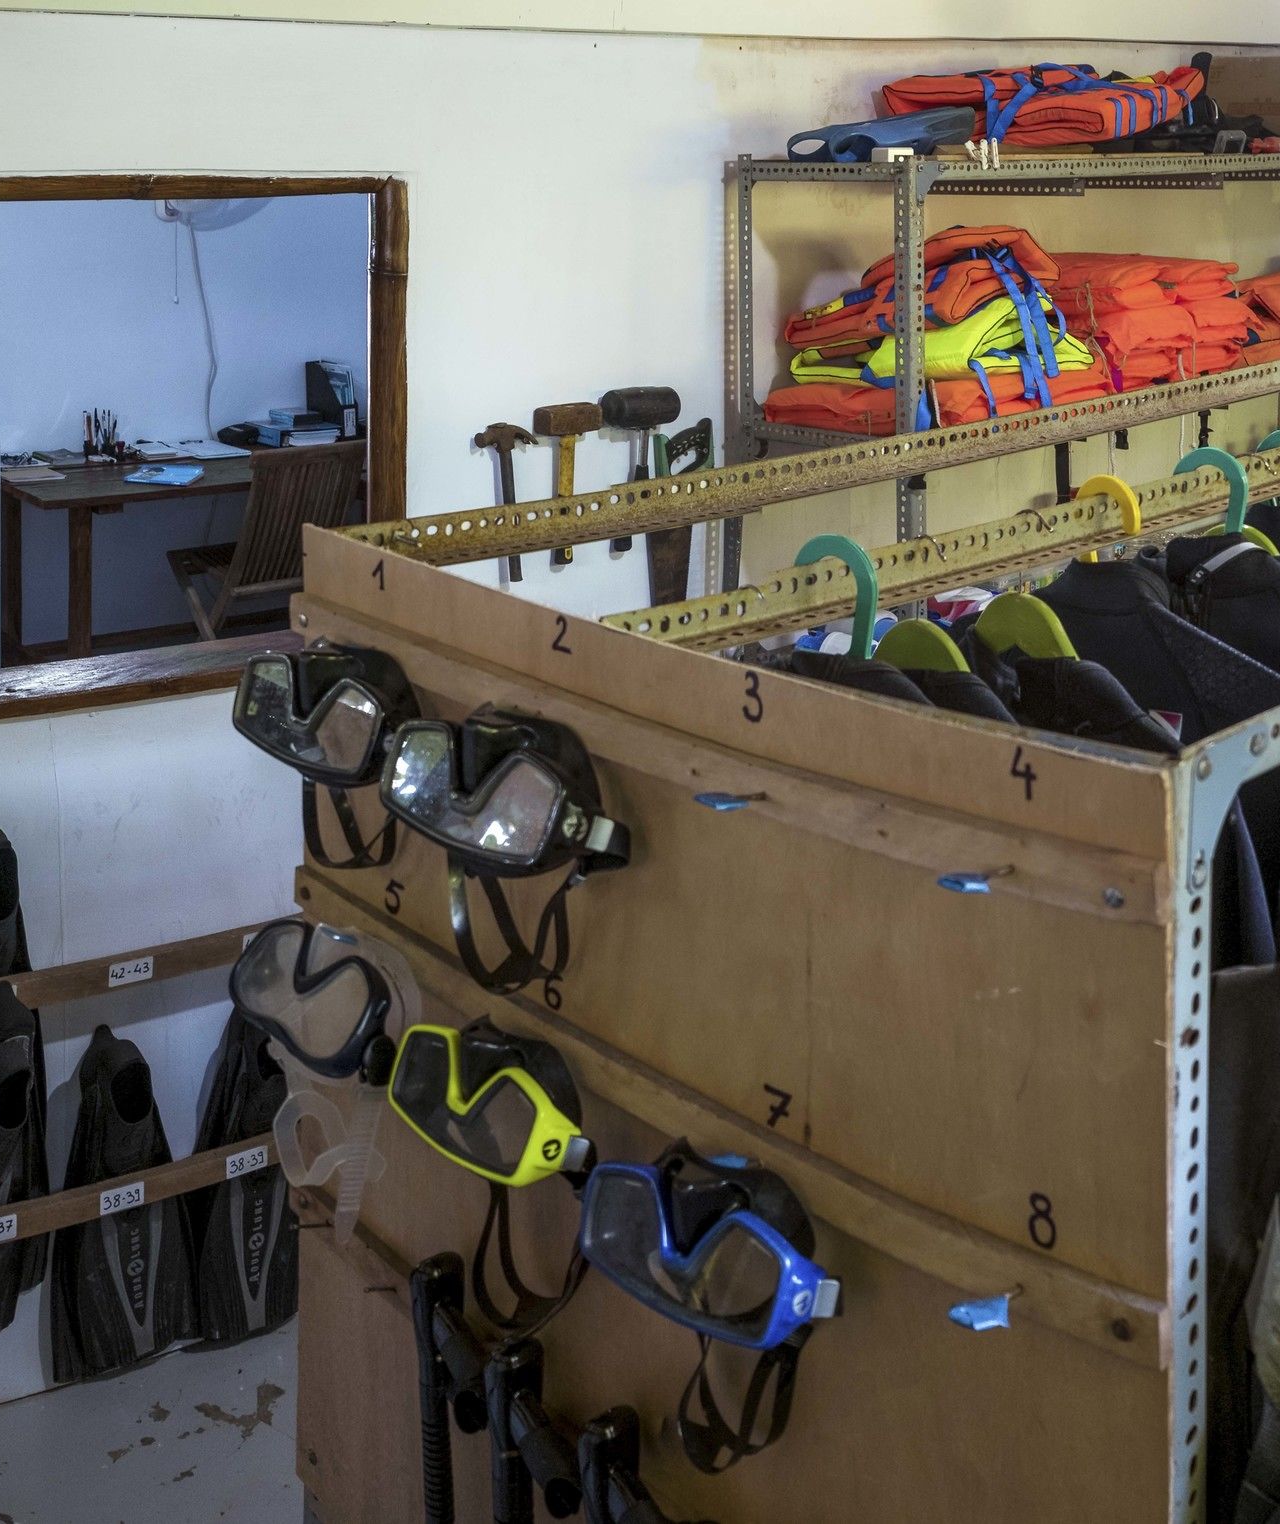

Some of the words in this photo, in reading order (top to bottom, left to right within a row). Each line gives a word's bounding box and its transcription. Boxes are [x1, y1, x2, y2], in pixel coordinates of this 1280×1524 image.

[372, 559, 386, 591] 1
[552, 615, 572, 655] 2
[742, 670, 764, 723] 3
[1010, 746, 1037, 801] 4
[385, 879, 405, 915] 5
[111, 962, 150, 980] 42-43
[544, 974, 563, 1010] 6
[764, 1083, 792, 1128] 7
[229, 1151, 264, 1174] 38-39
[103, 1188, 141, 1211] 38-39
[253, 1199, 263, 1231] LUNG
[1029, 1192, 1056, 1250] 8
[130, 1228, 140, 1259] LUNG
[249, 1249, 263, 1282] AQUA
[133, 1276, 144, 1309] AQUA
